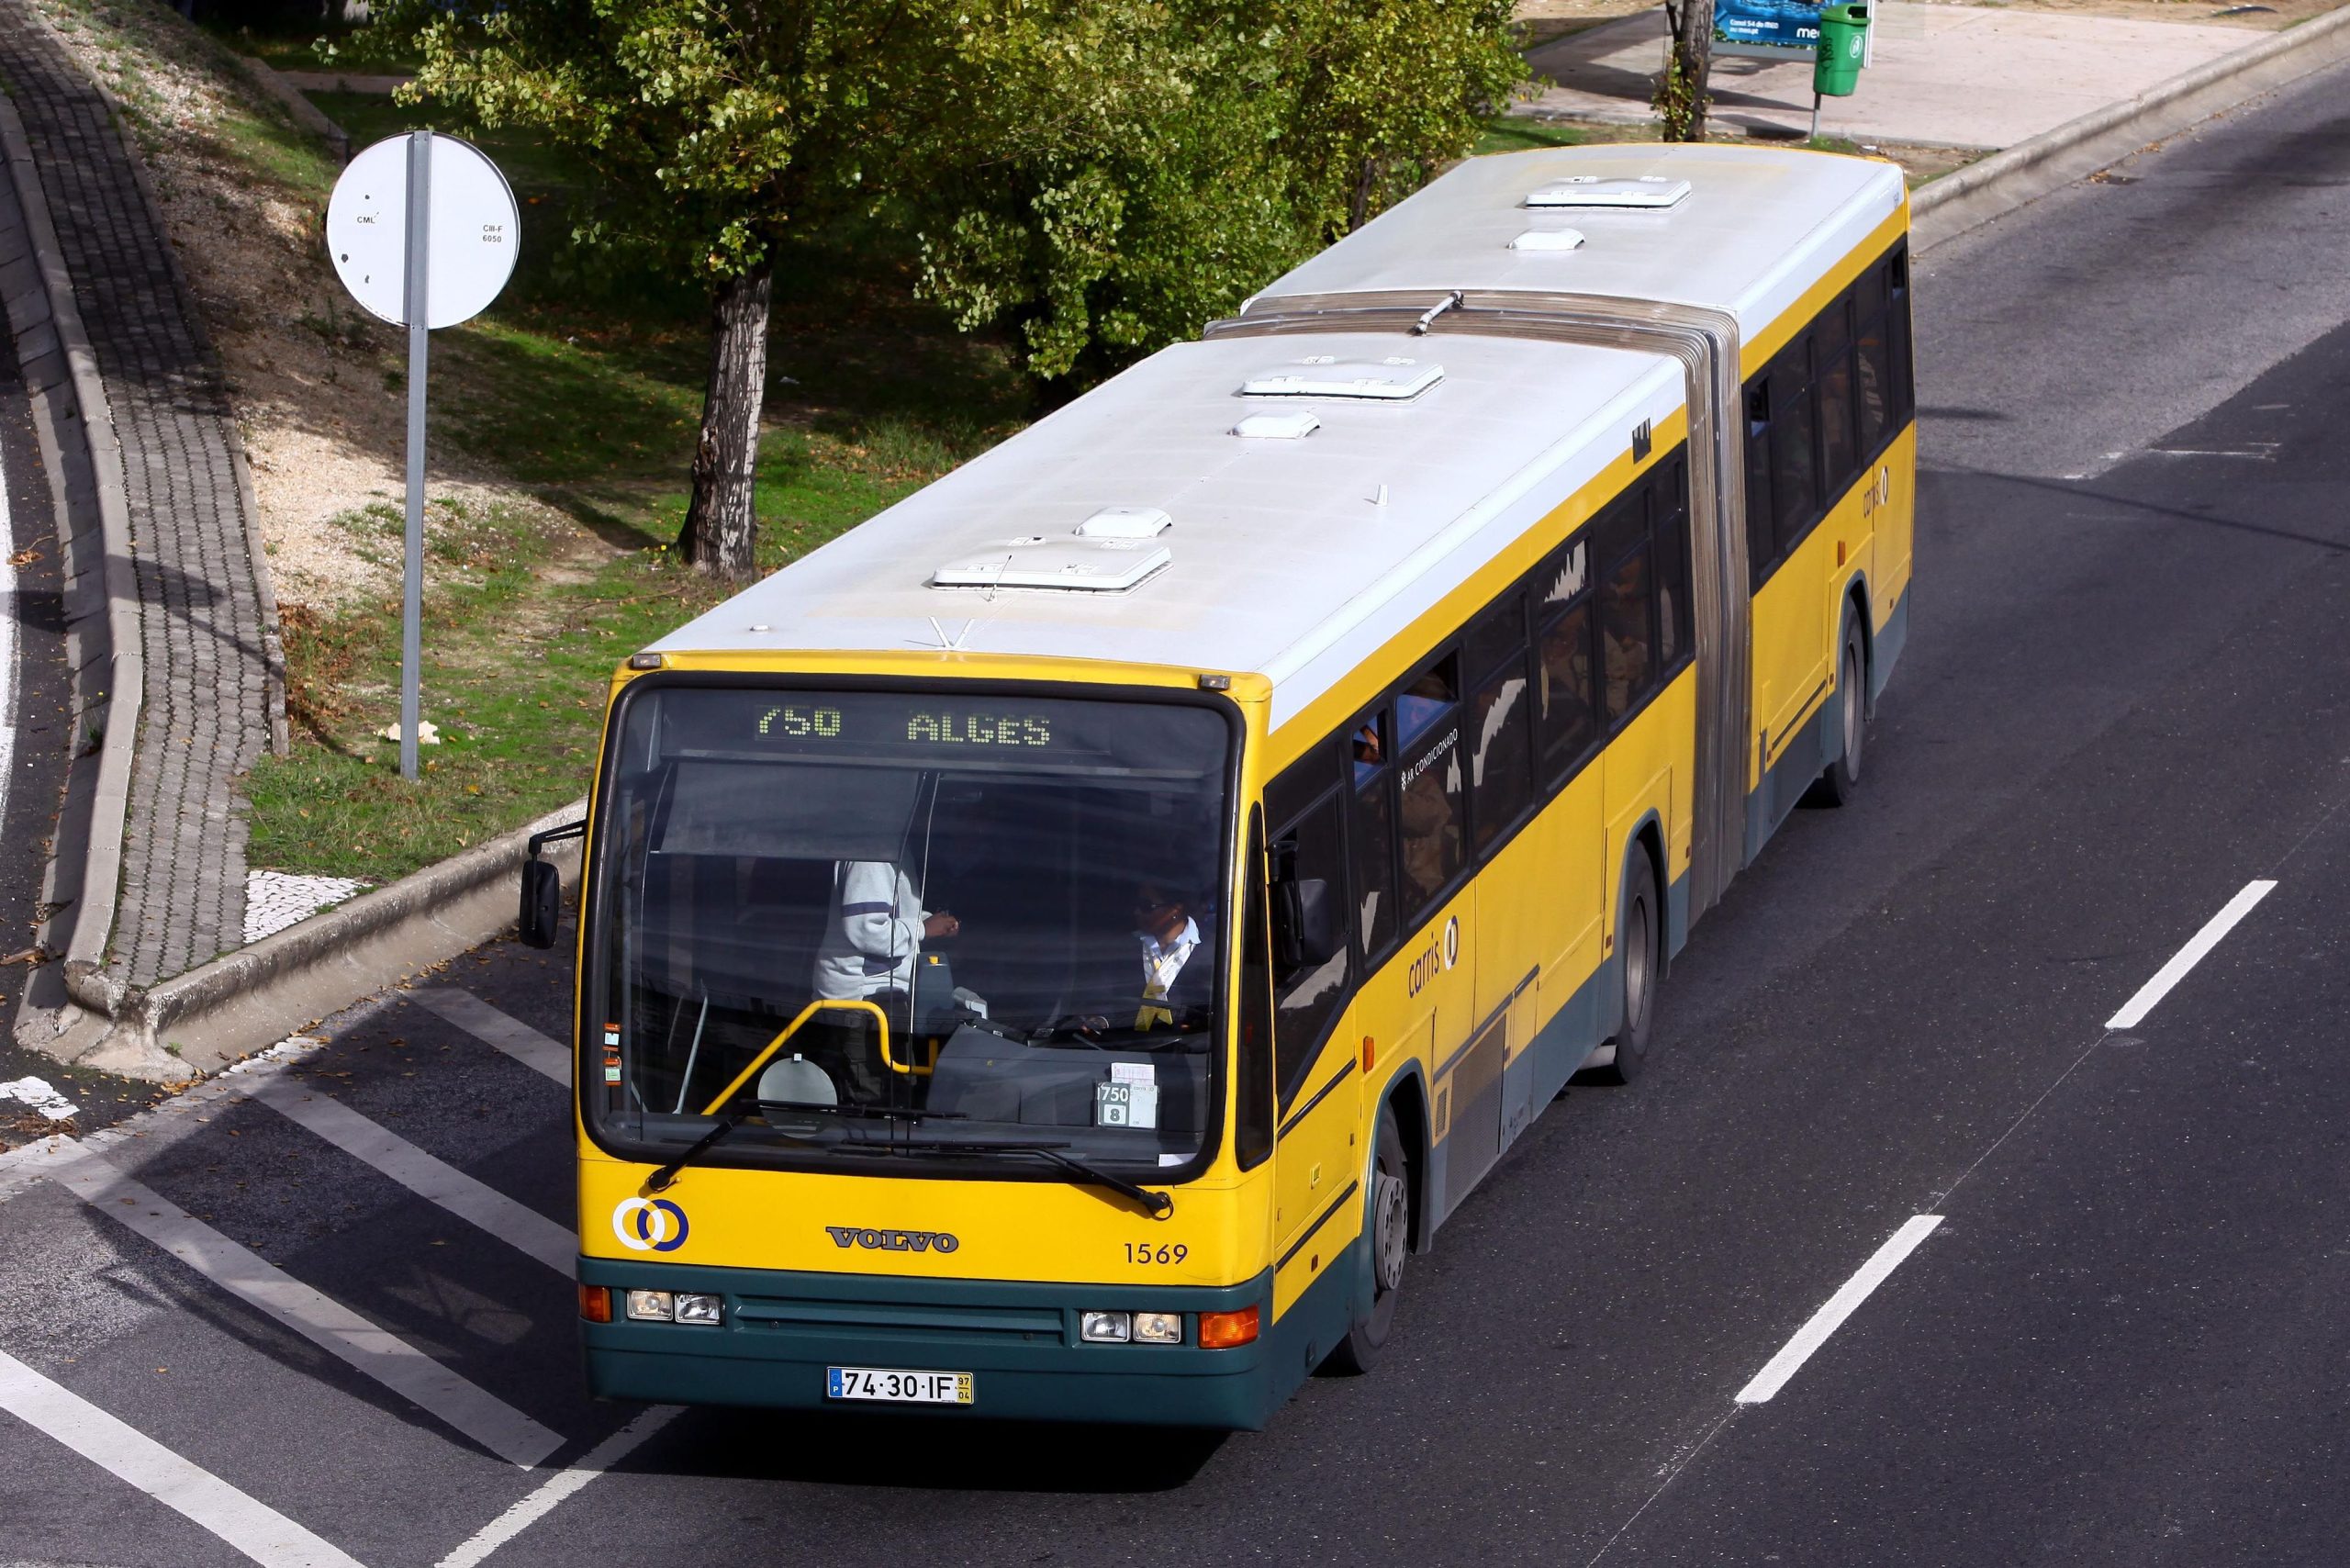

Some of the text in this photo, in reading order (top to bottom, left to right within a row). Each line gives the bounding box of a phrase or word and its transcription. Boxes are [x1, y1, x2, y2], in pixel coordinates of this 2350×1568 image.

[357, 216, 375, 224] CML
[758, 705, 841, 736] 750
[1415, 728, 1458, 776] CONDICIONADO
[1409, 931, 1439, 998] carris
[1102, 1086, 1129, 1103] 750
[1110, 1108, 1120, 1122] 8
[825, 1226, 959, 1253] VOLVO
[1124, 1243, 1188, 1265] 1569
[957, 1377, 969, 1385] 97
[958, 1391, 969, 1400] 04
